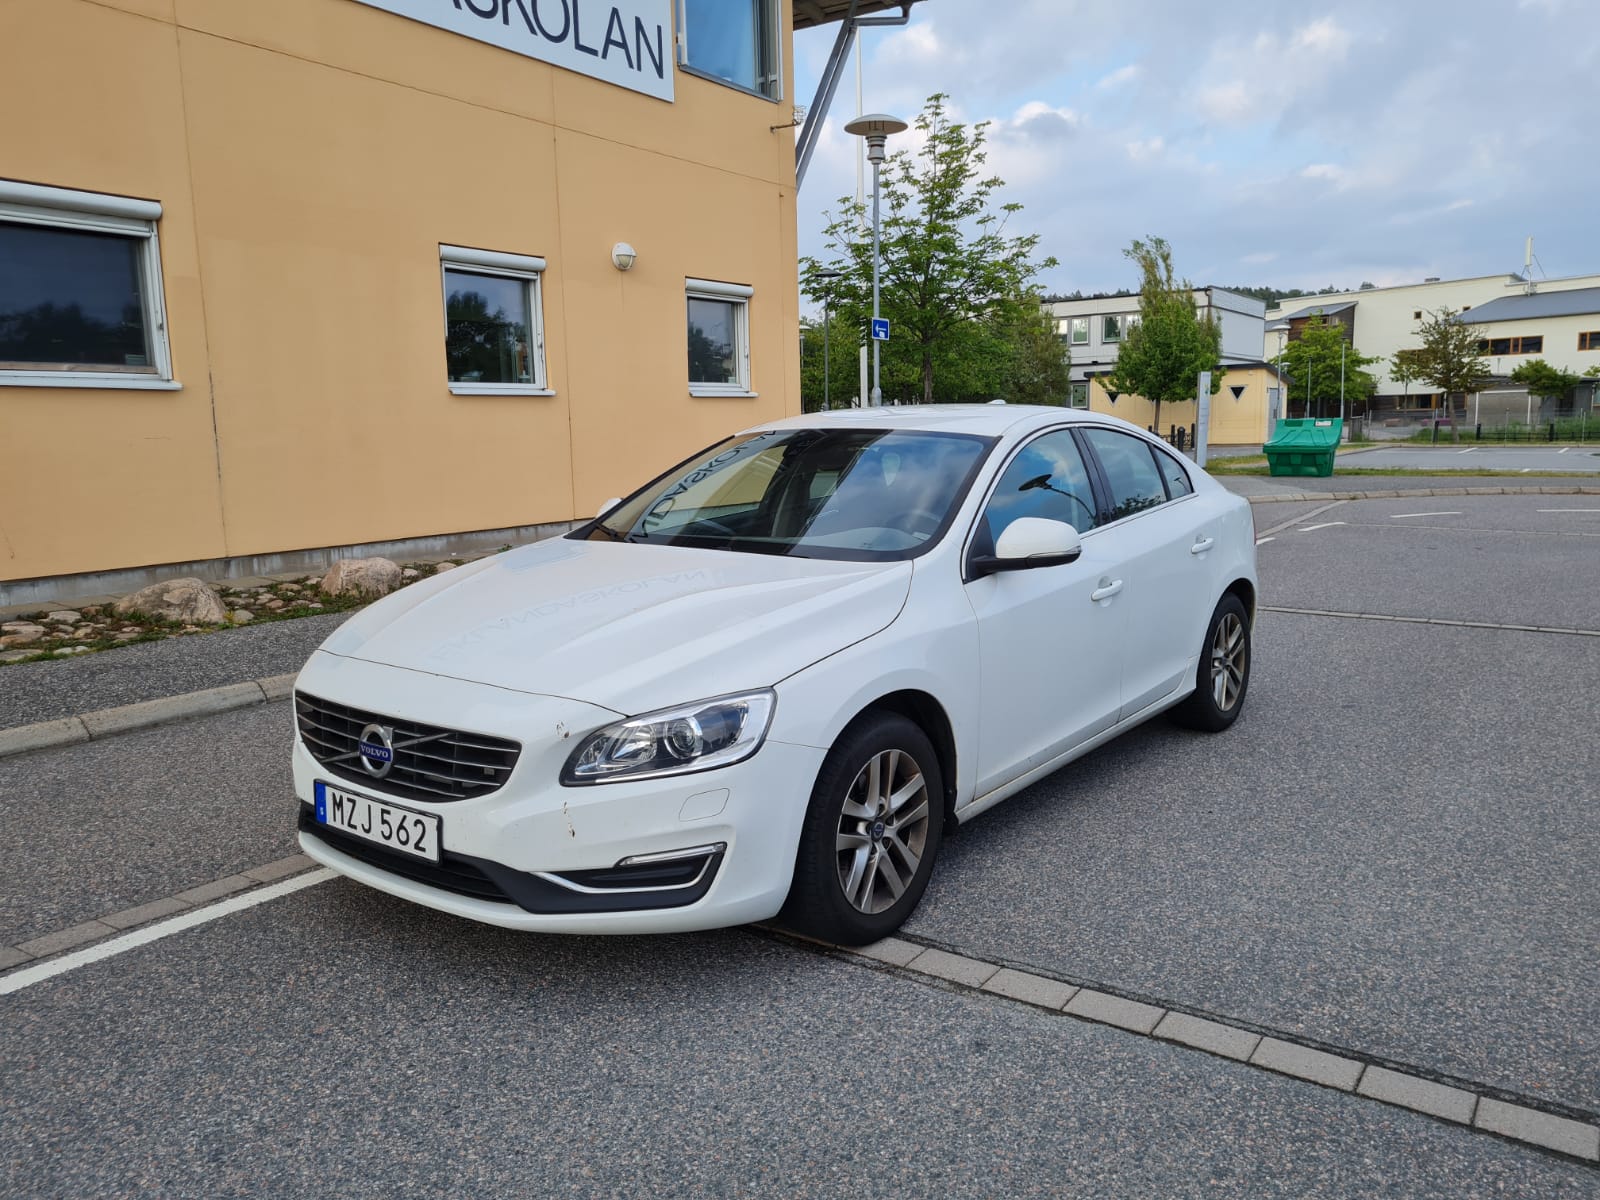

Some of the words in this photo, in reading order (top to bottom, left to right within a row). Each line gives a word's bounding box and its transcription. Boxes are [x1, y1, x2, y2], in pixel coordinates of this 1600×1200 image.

[453, 0, 664, 79] KOLAN
[360, 744, 389, 759] VOLVO
[332, 791, 371, 834] MZJ
[380, 808, 426, 853] 562
